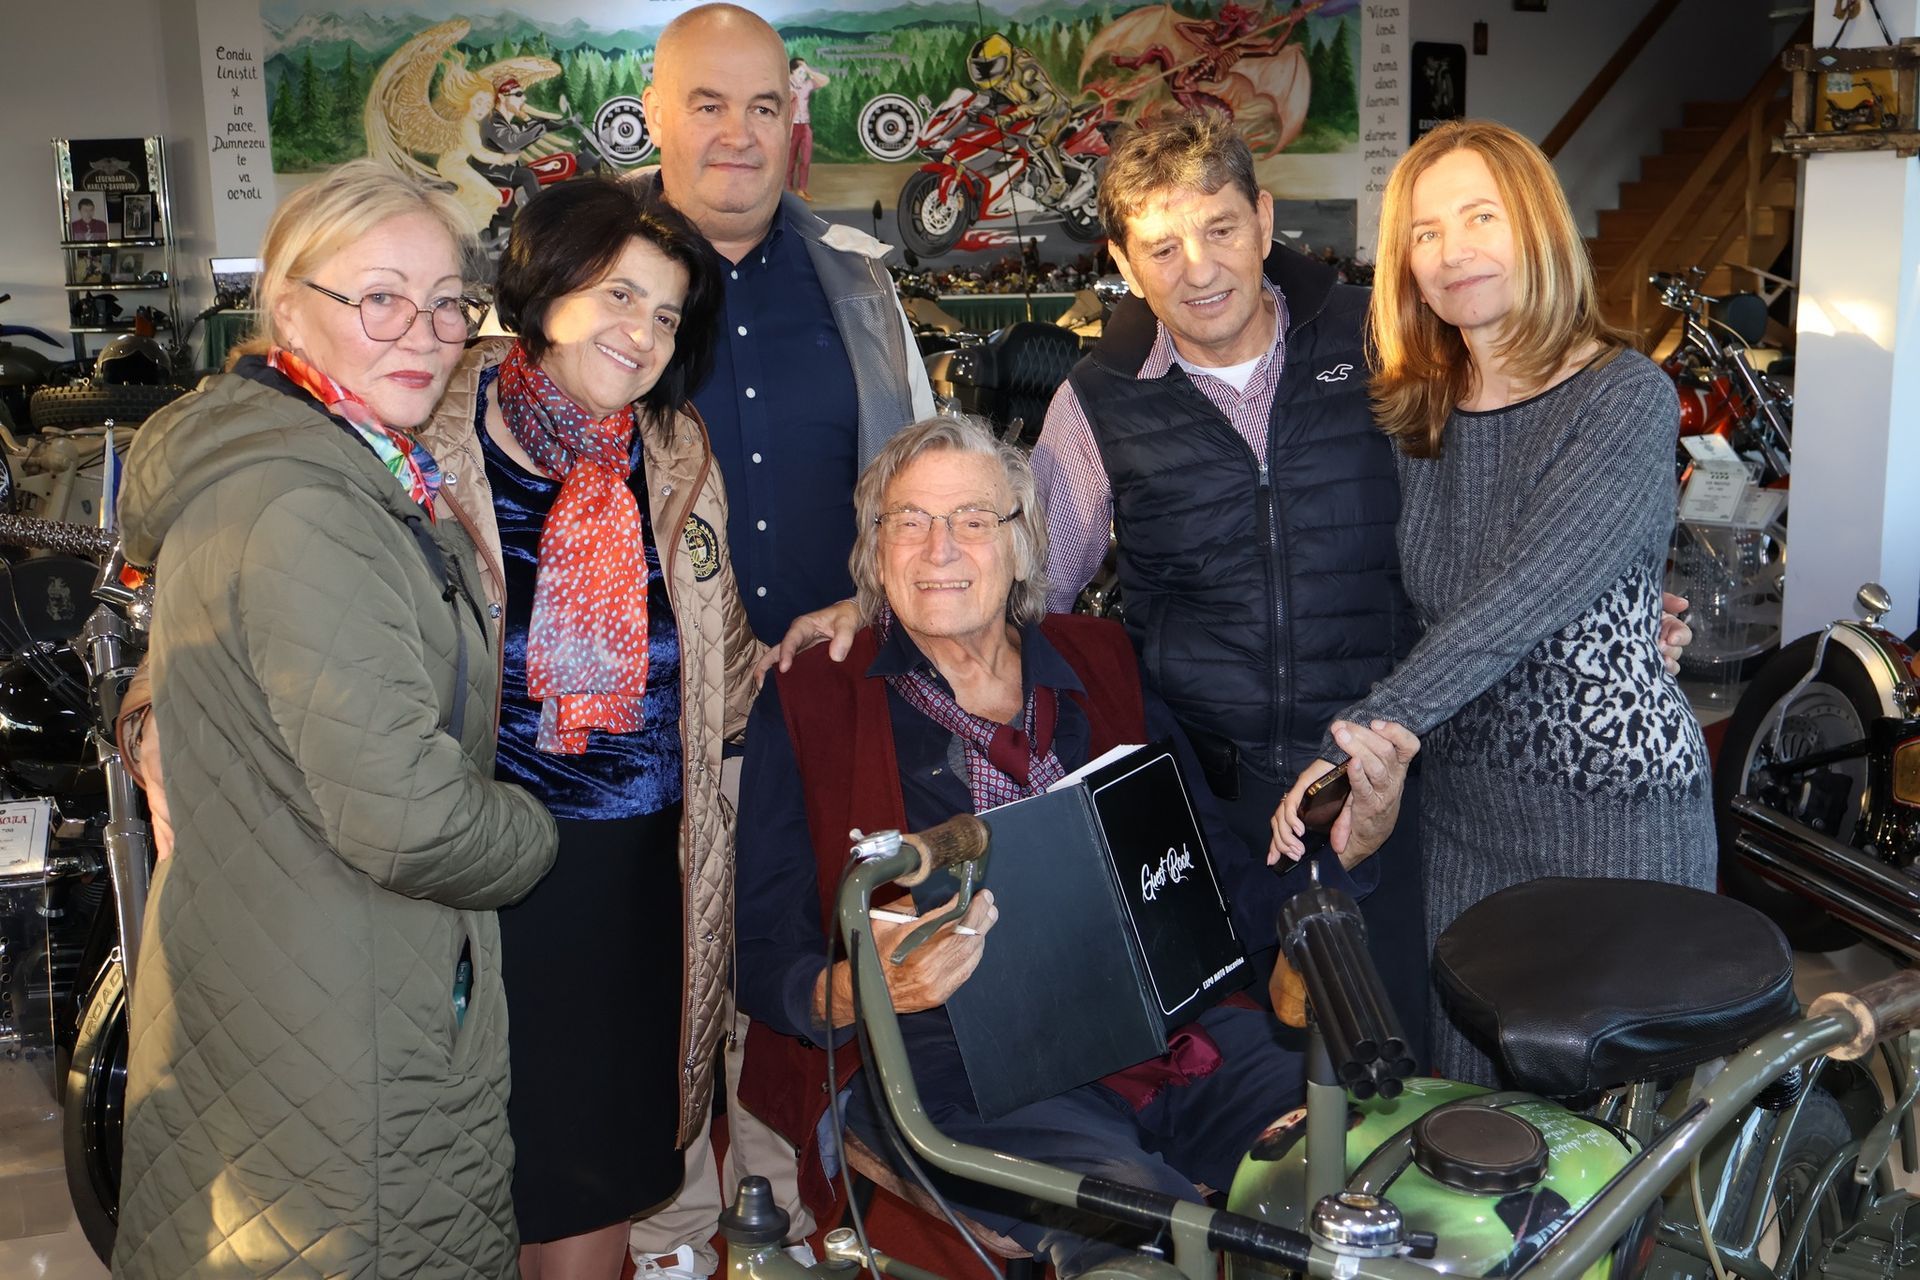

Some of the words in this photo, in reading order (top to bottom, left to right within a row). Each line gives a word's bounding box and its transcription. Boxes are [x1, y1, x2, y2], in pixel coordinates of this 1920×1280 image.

[215, 46, 253, 61] Condu
[212, 135, 266, 152] Dumnezeu
[237, 154, 247, 166] te
[1365, 146, 1398, 160] pentru
[95, 175, 126, 183] LEGENDARY
[238, 173, 251, 183] va
[227, 186, 262, 200] ocroti
[1141, 856, 1168, 903] Guest
[1166, 842, 1195, 883] Book
[1203, 976, 1215, 990] EXPO
[1213, 968, 1226, 982] MOTO
